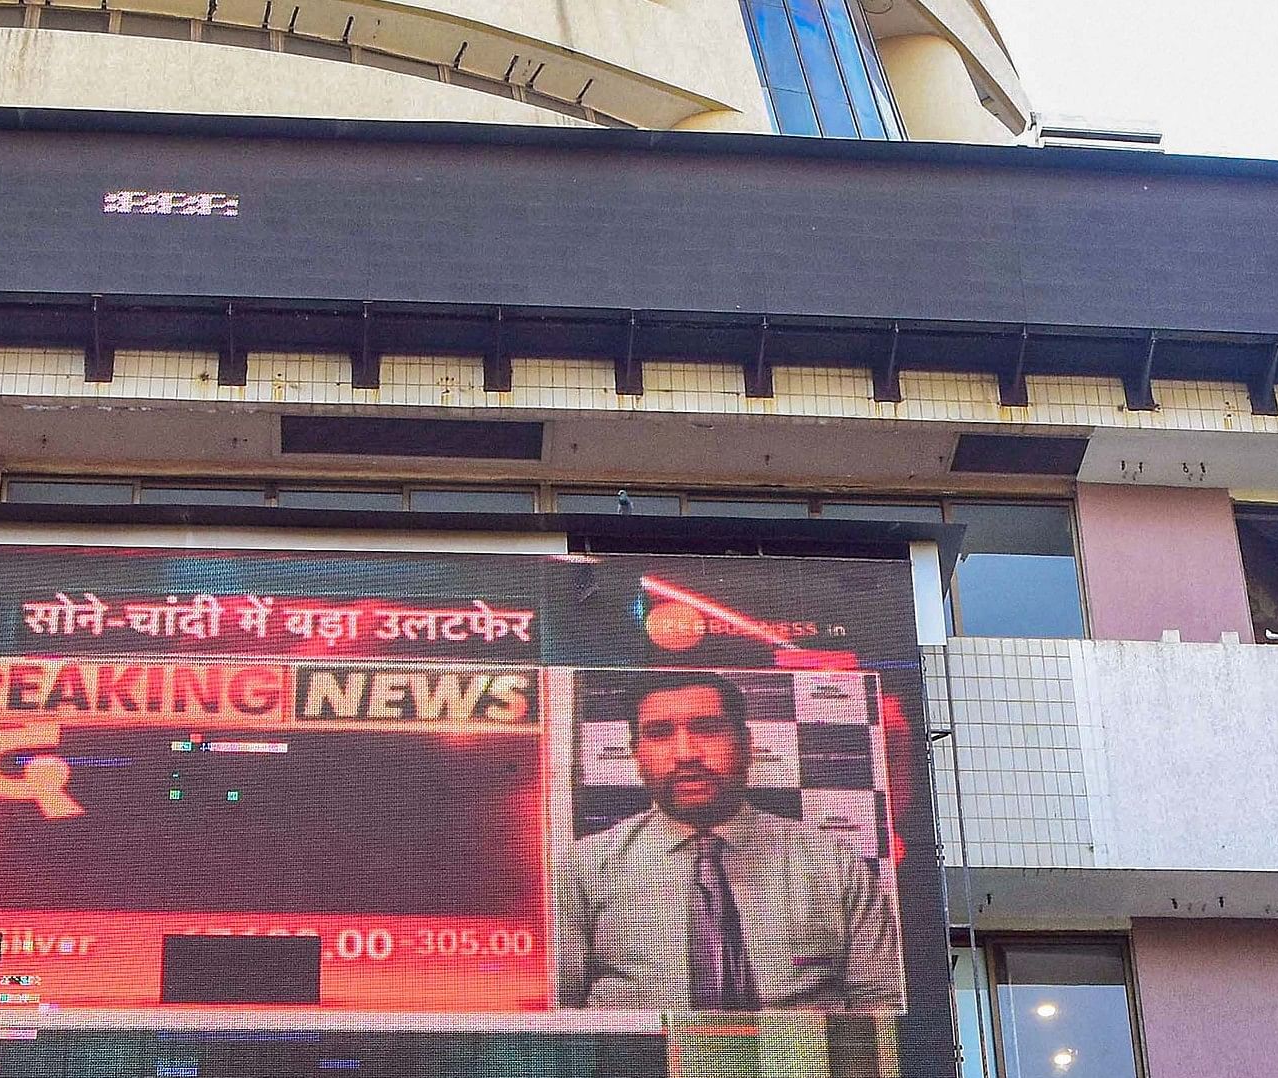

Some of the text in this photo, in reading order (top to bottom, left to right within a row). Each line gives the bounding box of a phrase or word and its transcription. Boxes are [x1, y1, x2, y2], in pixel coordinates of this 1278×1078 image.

[237, 596, 276, 639] में
[375, 599, 534, 643] उलटफेर
[301, 671, 531, 722] NEWS
